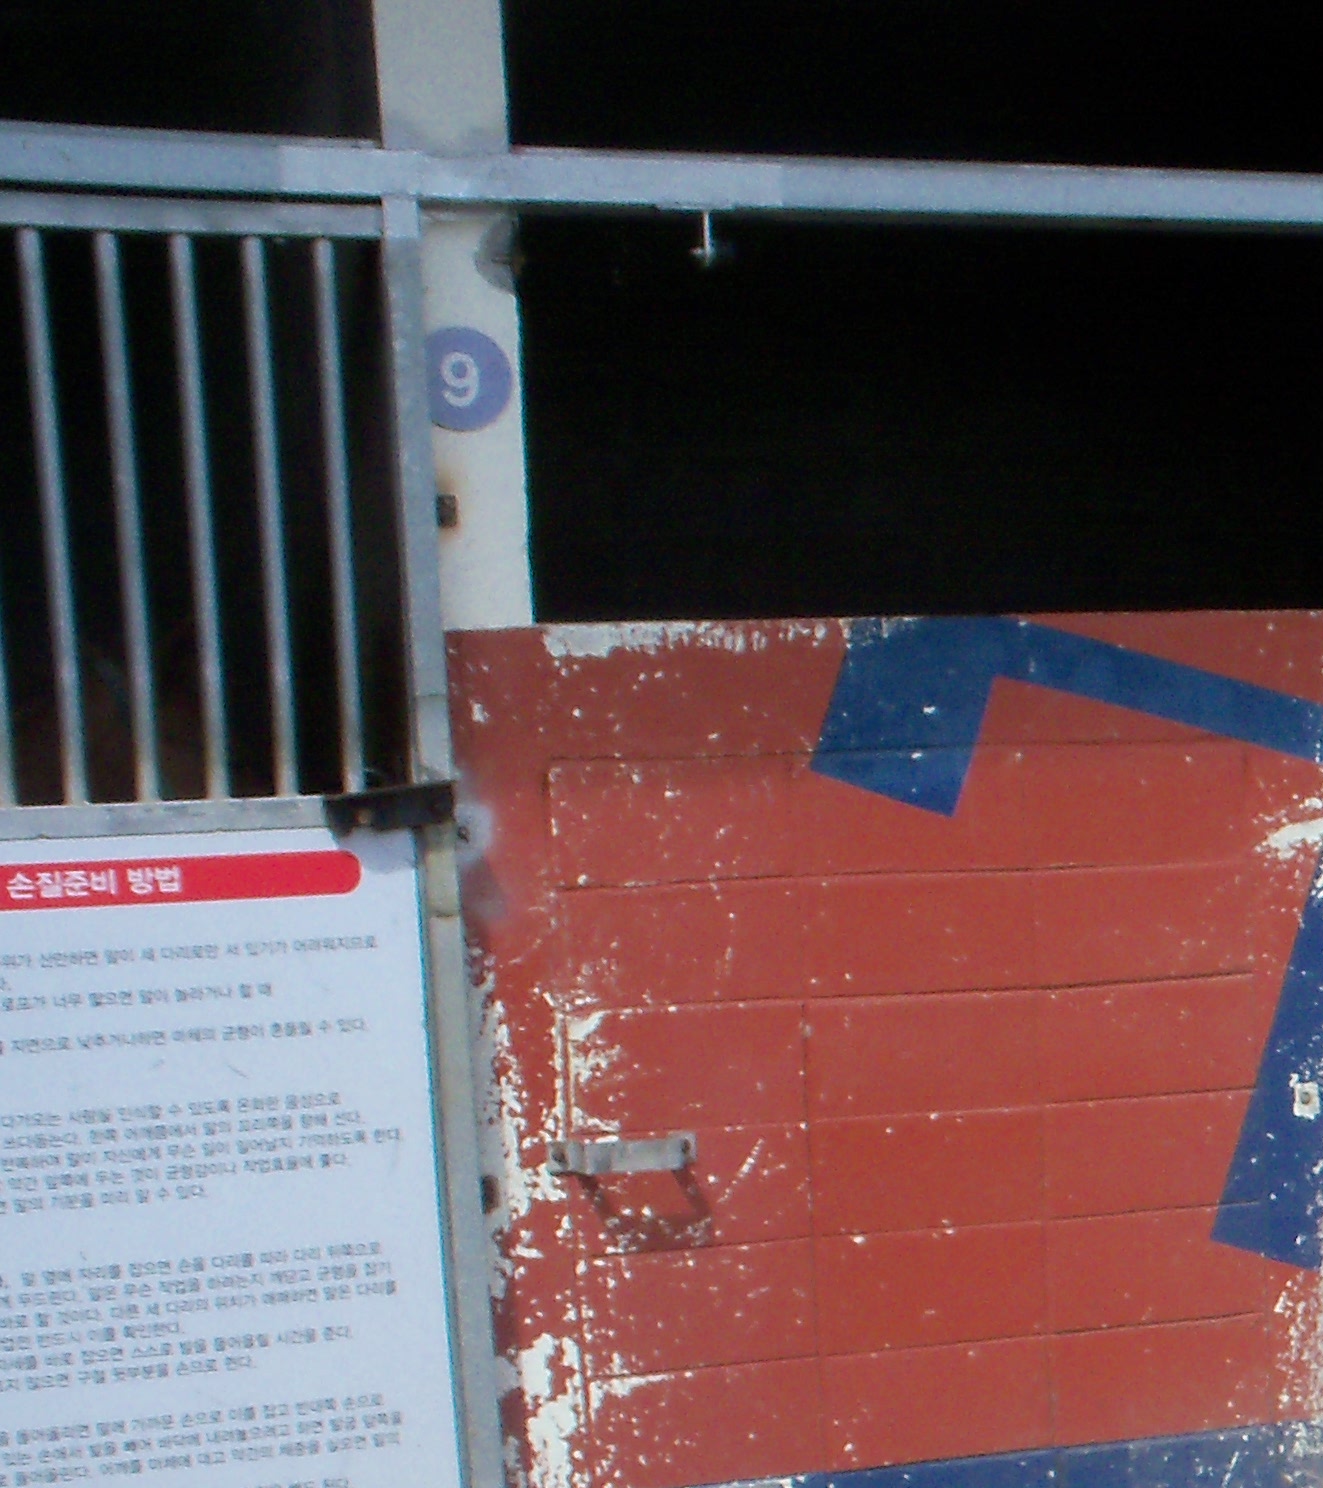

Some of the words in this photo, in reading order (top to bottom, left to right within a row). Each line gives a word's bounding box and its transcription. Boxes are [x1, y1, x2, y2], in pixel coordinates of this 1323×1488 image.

[440, 351, 480, 409] 9
[6, 868, 118, 900] 손질준비
[126, 865, 183, 895] 방법
